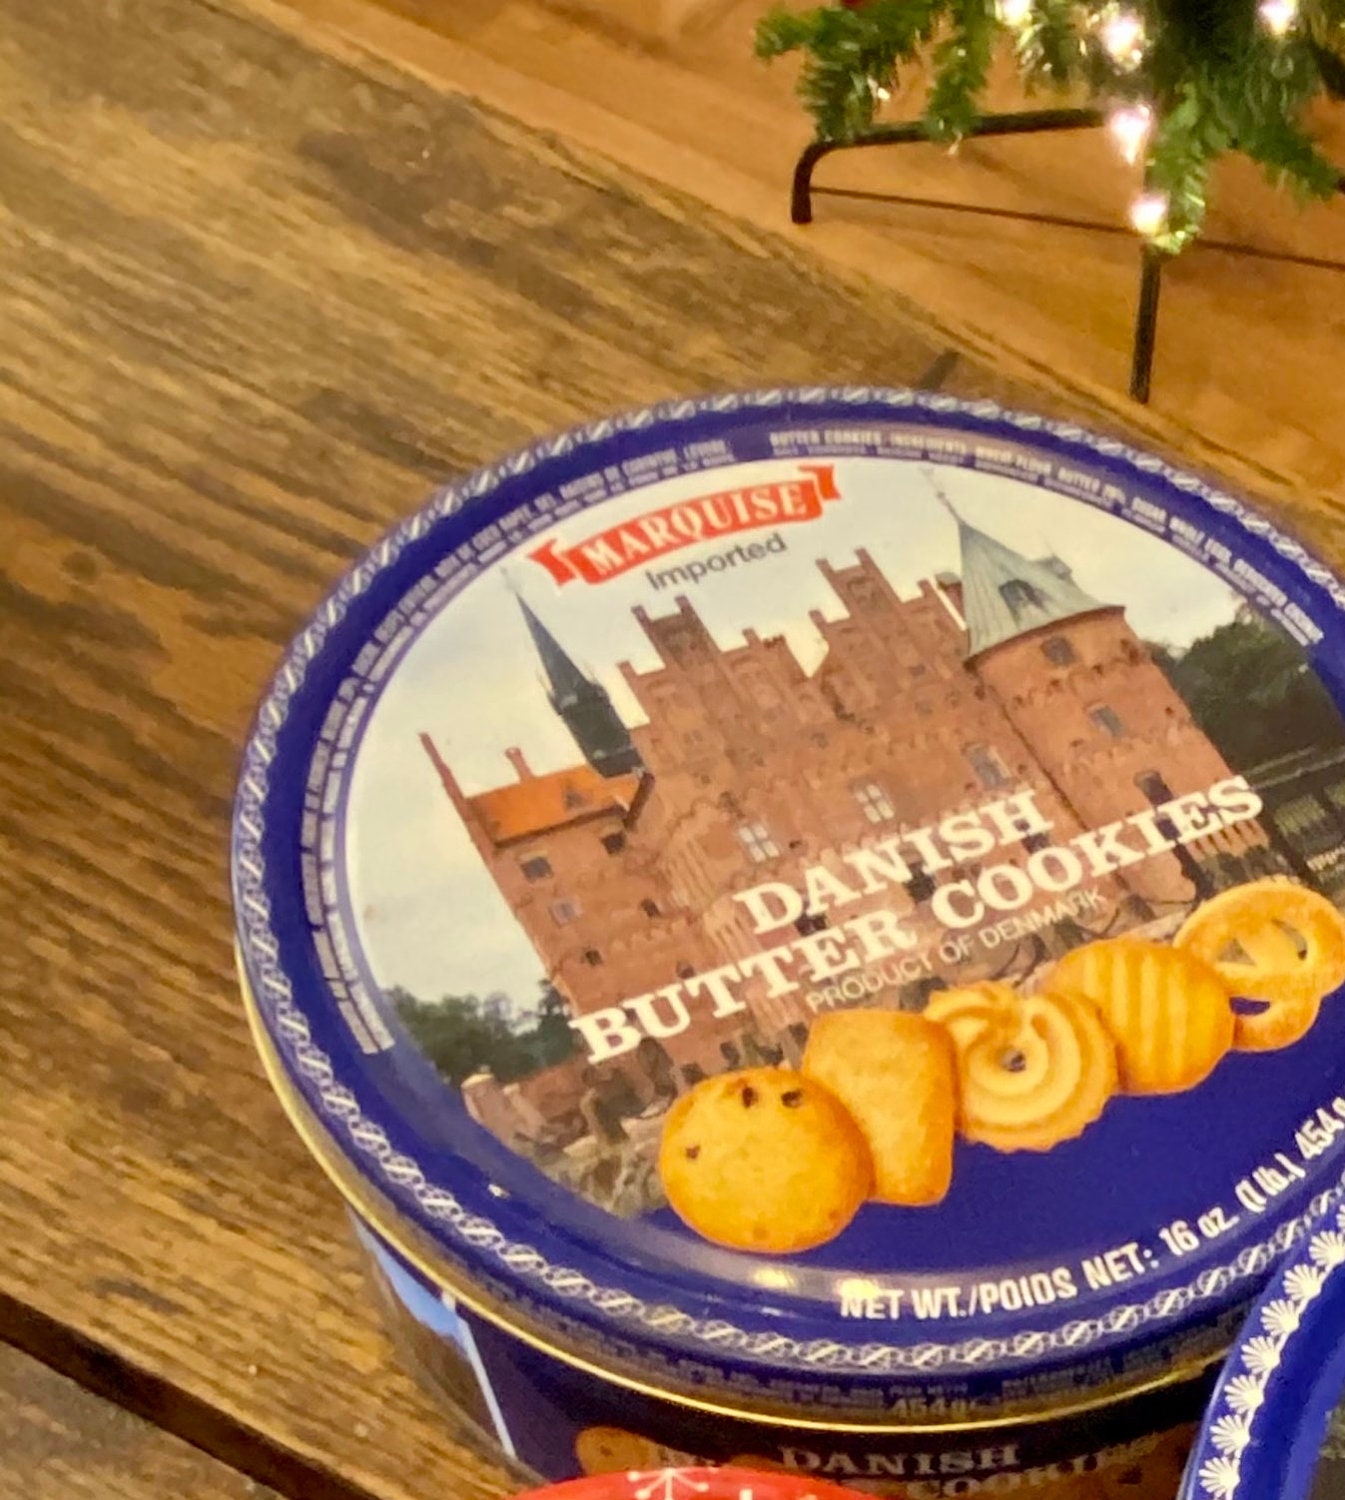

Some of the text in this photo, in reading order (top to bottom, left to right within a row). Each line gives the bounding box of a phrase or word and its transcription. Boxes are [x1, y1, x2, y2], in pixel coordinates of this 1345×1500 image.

[580, 482, 808, 577] MARQUISE
[647, 534, 788, 591] Imported
[732, 788, 1054, 934] DANISH
[568, 906, 917, 1065] BUTTER
[930, 775, 1264, 930] COOKIES
[805, 888, 1107, 1013] PRODUCT OF DENMARK
[839, 1286, 902, 1320] NET
[1081, 1242, 1160, 1290] NET:
[1159, 1220, 1199, 1256] 16
[779, 1444, 1020, 1477] DANISH
